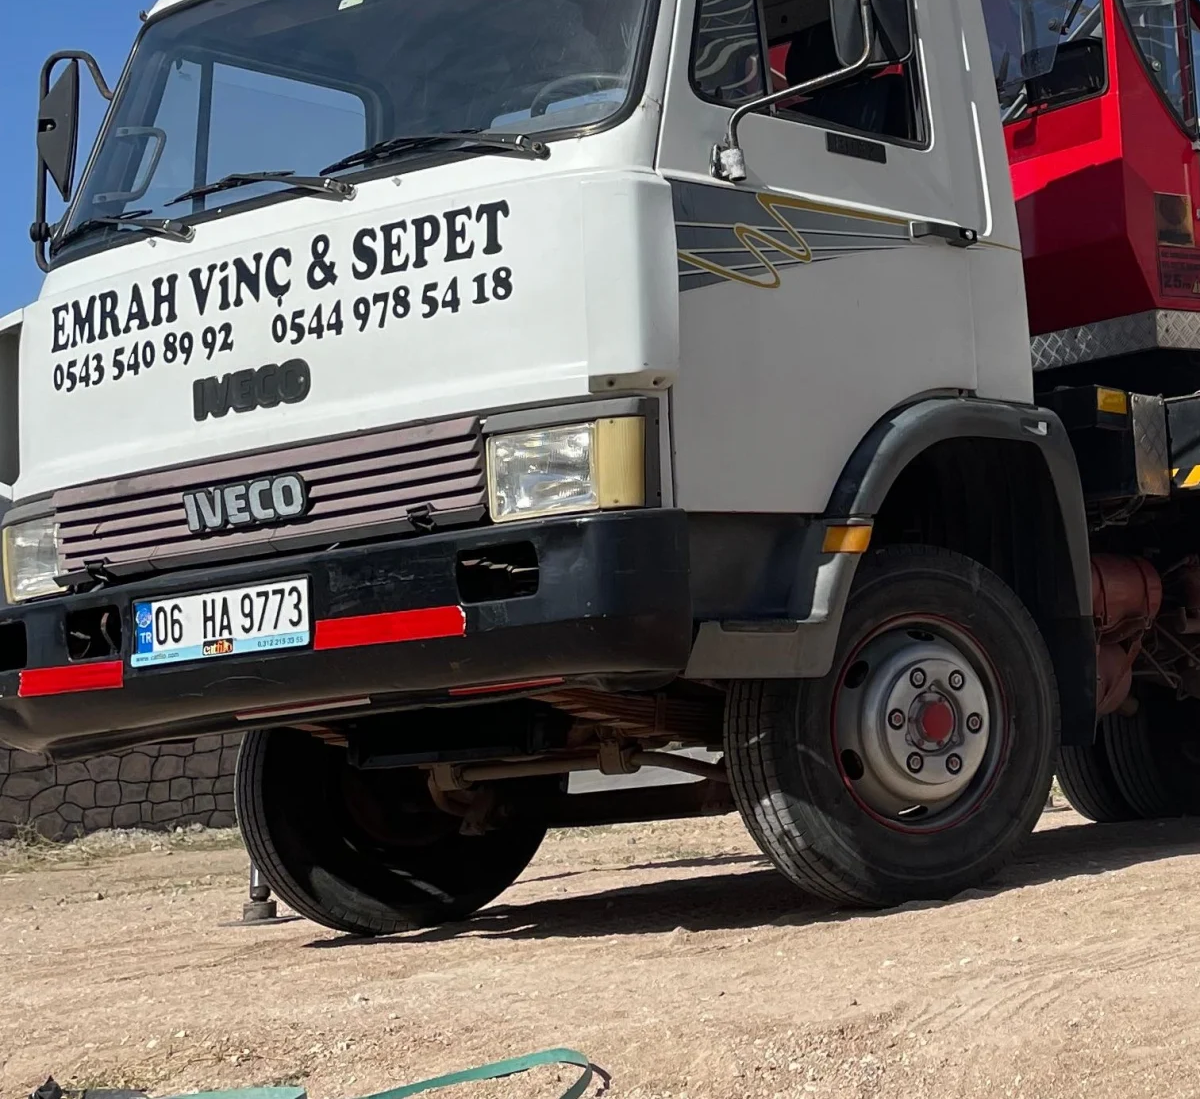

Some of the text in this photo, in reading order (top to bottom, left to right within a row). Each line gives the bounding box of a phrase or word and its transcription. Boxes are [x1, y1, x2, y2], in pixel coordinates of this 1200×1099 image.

[51, 273, 179, 354] EMRAH
[306, 233, 339, 291] &
[351, 199, 511, 281] SEPET
[271, 266, 513, 345] 0544 978 54 18
[53, 322, 234, 392] 0543 540 89 92
[193, 358, 311, 422] IVECO
[183, 475, 304, 532] IVECO
[140, 632, 153, 645] TR
[155, 586, 303, 646] 06 HA 9773
